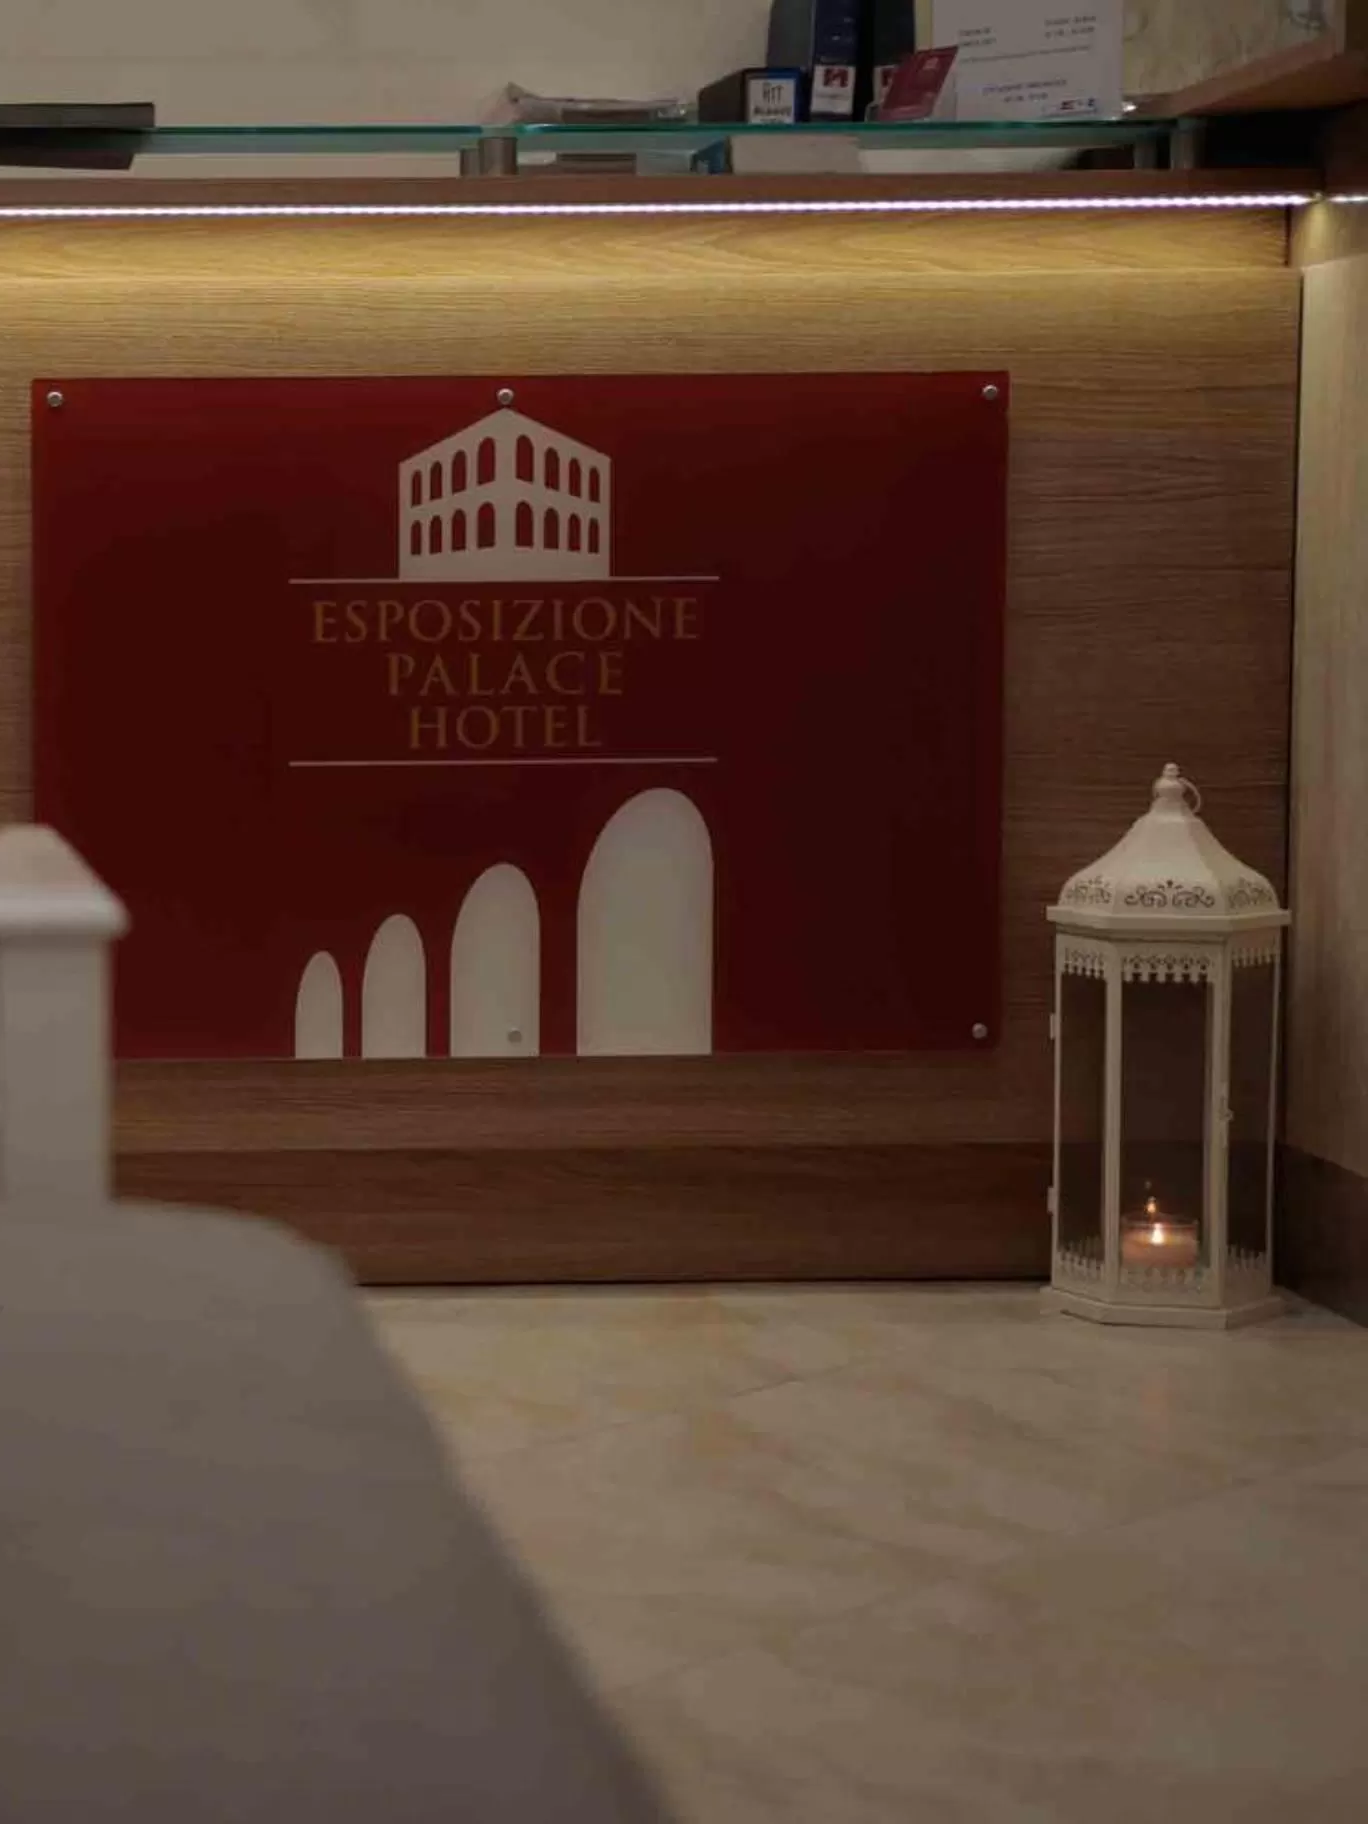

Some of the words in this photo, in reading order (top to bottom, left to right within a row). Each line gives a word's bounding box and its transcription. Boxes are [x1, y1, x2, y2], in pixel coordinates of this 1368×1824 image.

[311, 597, 699, 643] ESPOSIZIONE
[386, 651, 624, 697] PALACE
[409, 705, 603, 750] HOTEL
